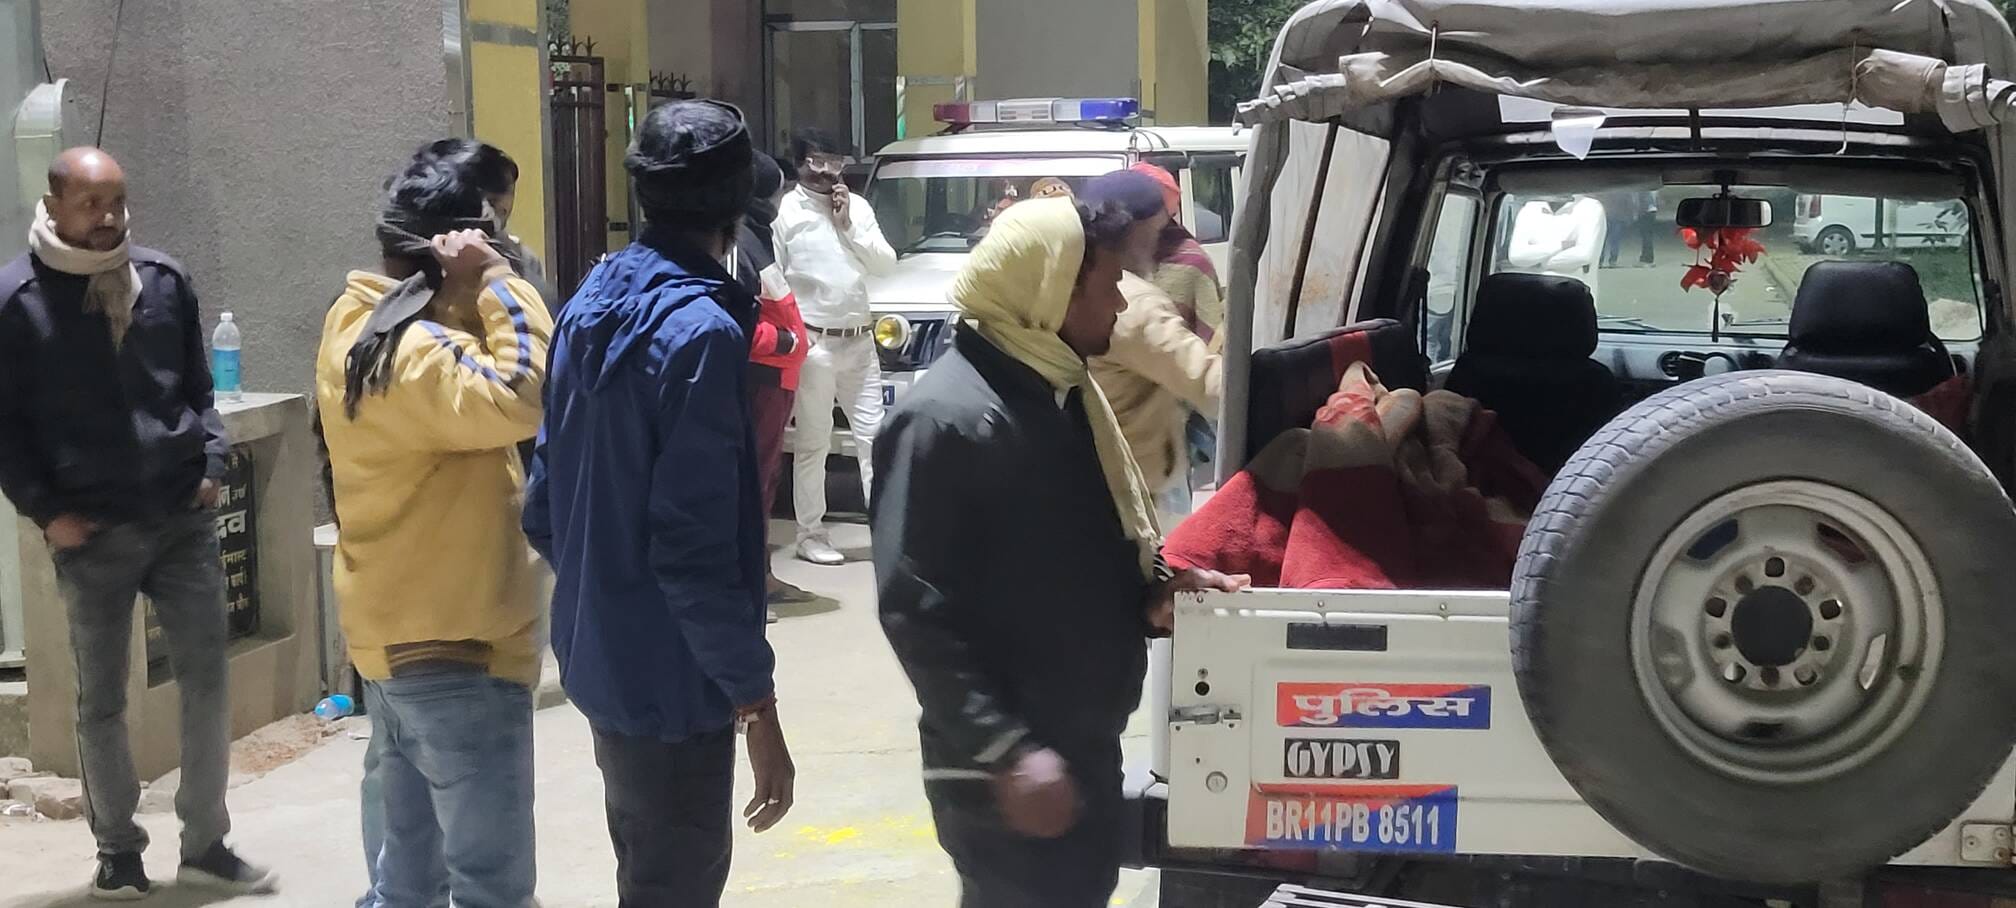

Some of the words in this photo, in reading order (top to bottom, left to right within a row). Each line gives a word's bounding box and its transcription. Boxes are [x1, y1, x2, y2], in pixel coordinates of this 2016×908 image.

[1292, 687, 1475, 725] पुलिस
[1287, 741, 1396, 778] GYPSY
[1266, 801, 1369, 843] BR11PB
[1377, 804, 1439, 846] 8511
